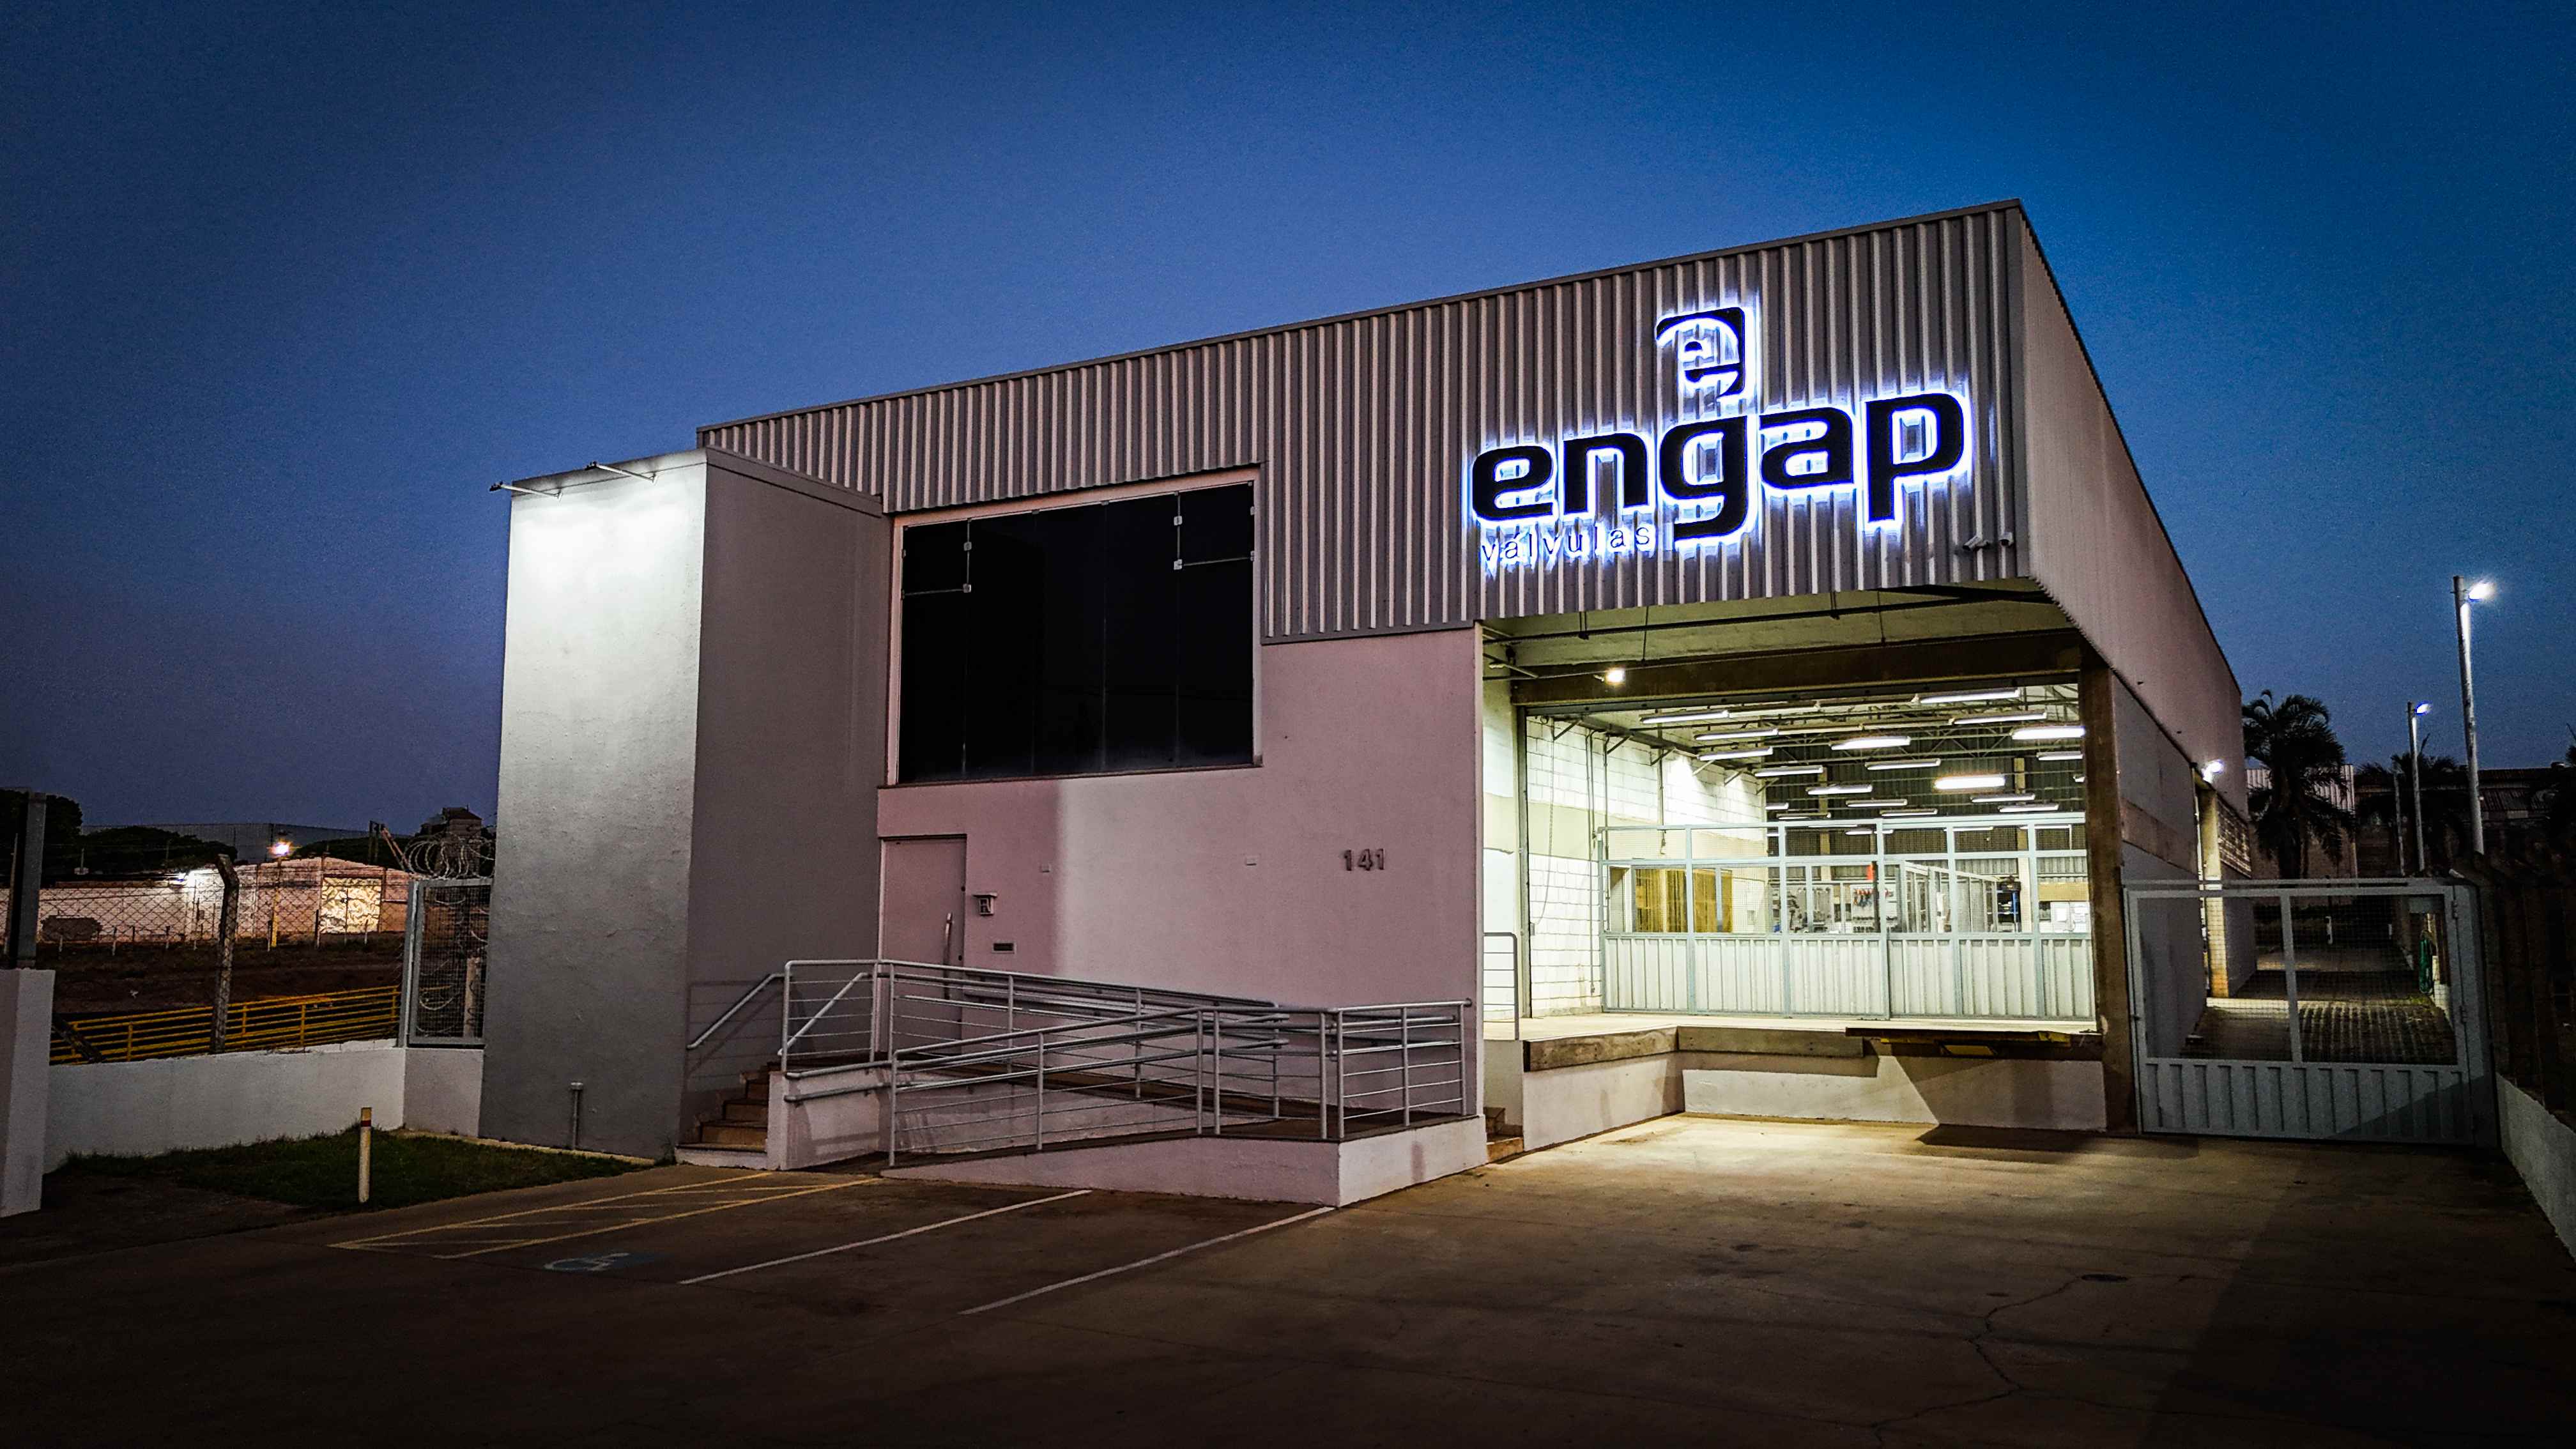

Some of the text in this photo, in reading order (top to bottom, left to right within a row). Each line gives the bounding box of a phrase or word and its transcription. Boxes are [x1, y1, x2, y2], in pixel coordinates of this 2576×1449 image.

[1471, 392, 1965, 540] engap
[1482, 526, 1651, 561] válvulas
[1344, 848, 1384, 871] 141
